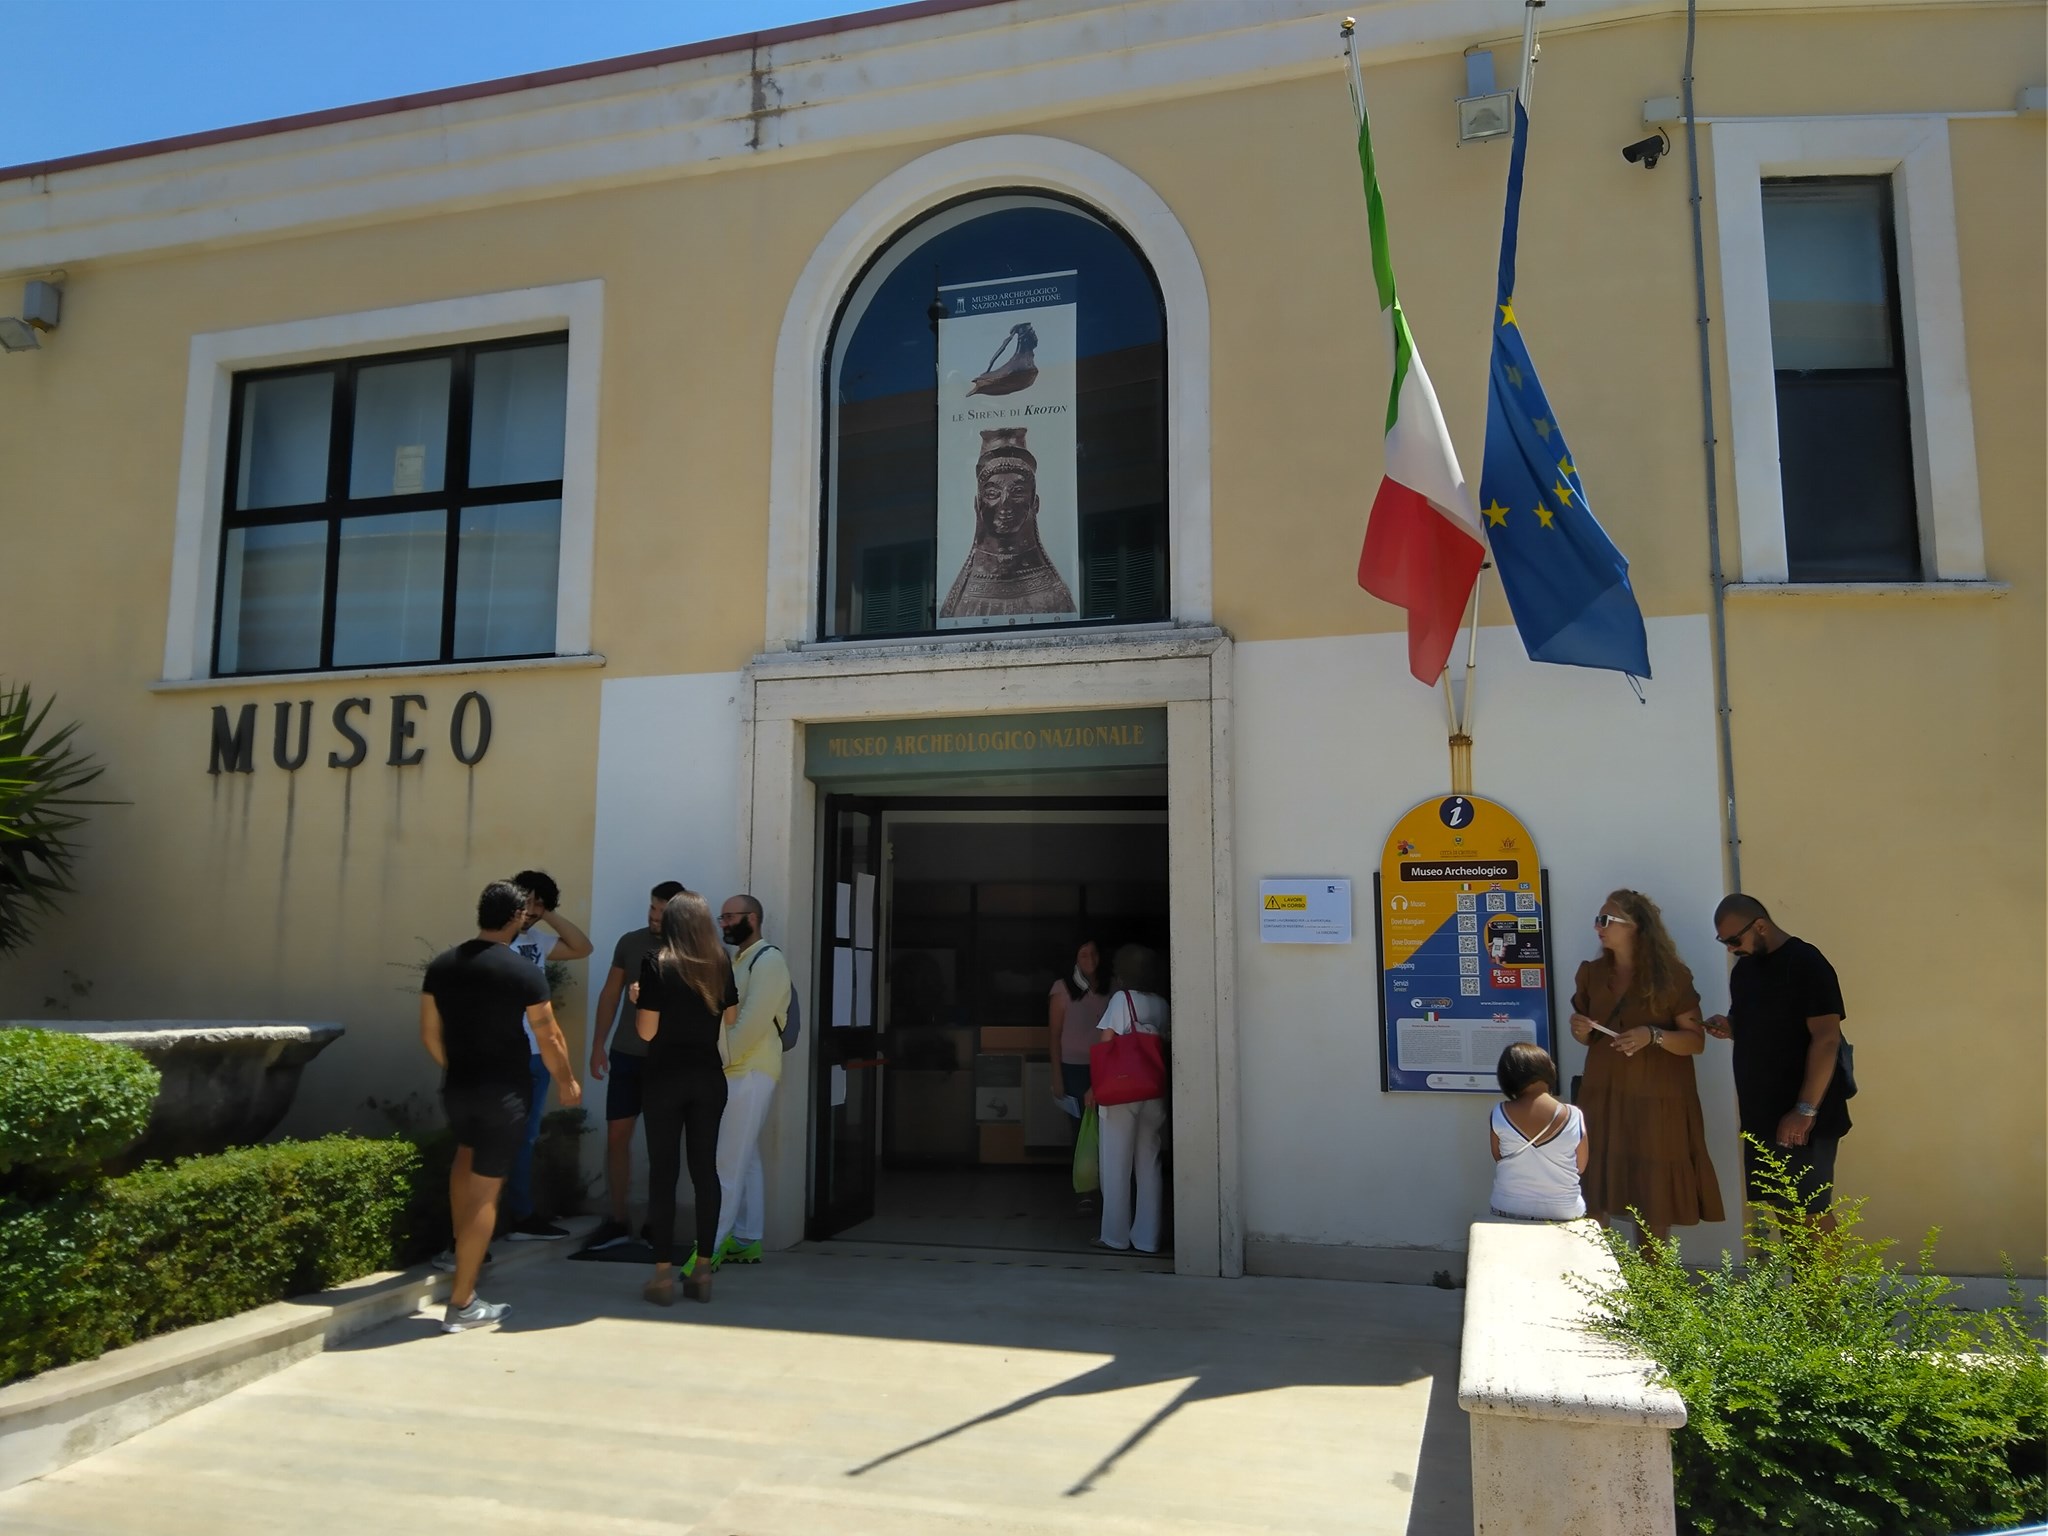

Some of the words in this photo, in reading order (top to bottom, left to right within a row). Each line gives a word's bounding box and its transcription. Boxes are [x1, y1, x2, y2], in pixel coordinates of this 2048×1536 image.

[971, 294, 998, 304] MUSEO
[999, 286, 1058, 300] ARCHEOLOGICO
[971, 300, 1015, 310] NAZIONALE
[1016, 298, 1025, 306] DI
[1025, 293, 1062, 304] CROTONE
[952, 413, 965, 423] LE
[967, 408, 1006, 421] SIRENE
[1010, 408, 1020, 417] DI
[1024, 404, 1068, 416] KROTON
[206, 690, 492, 775] MUSEO
[828, 736, 887, 758] MUSEO
[892, 730, 1037, 755] ARCHEOLOGICO
[1040, 724, 1145, 749] NAZIONALE
[1411, 867, 1443, 877] Museo
[1444, 865, 1508, 878] Archeologico
[1392, 962, 1415, 971] Shopping
[1393, 979, 1409, 987] Servizi
[1496, 976, 1516, 984] SOS
